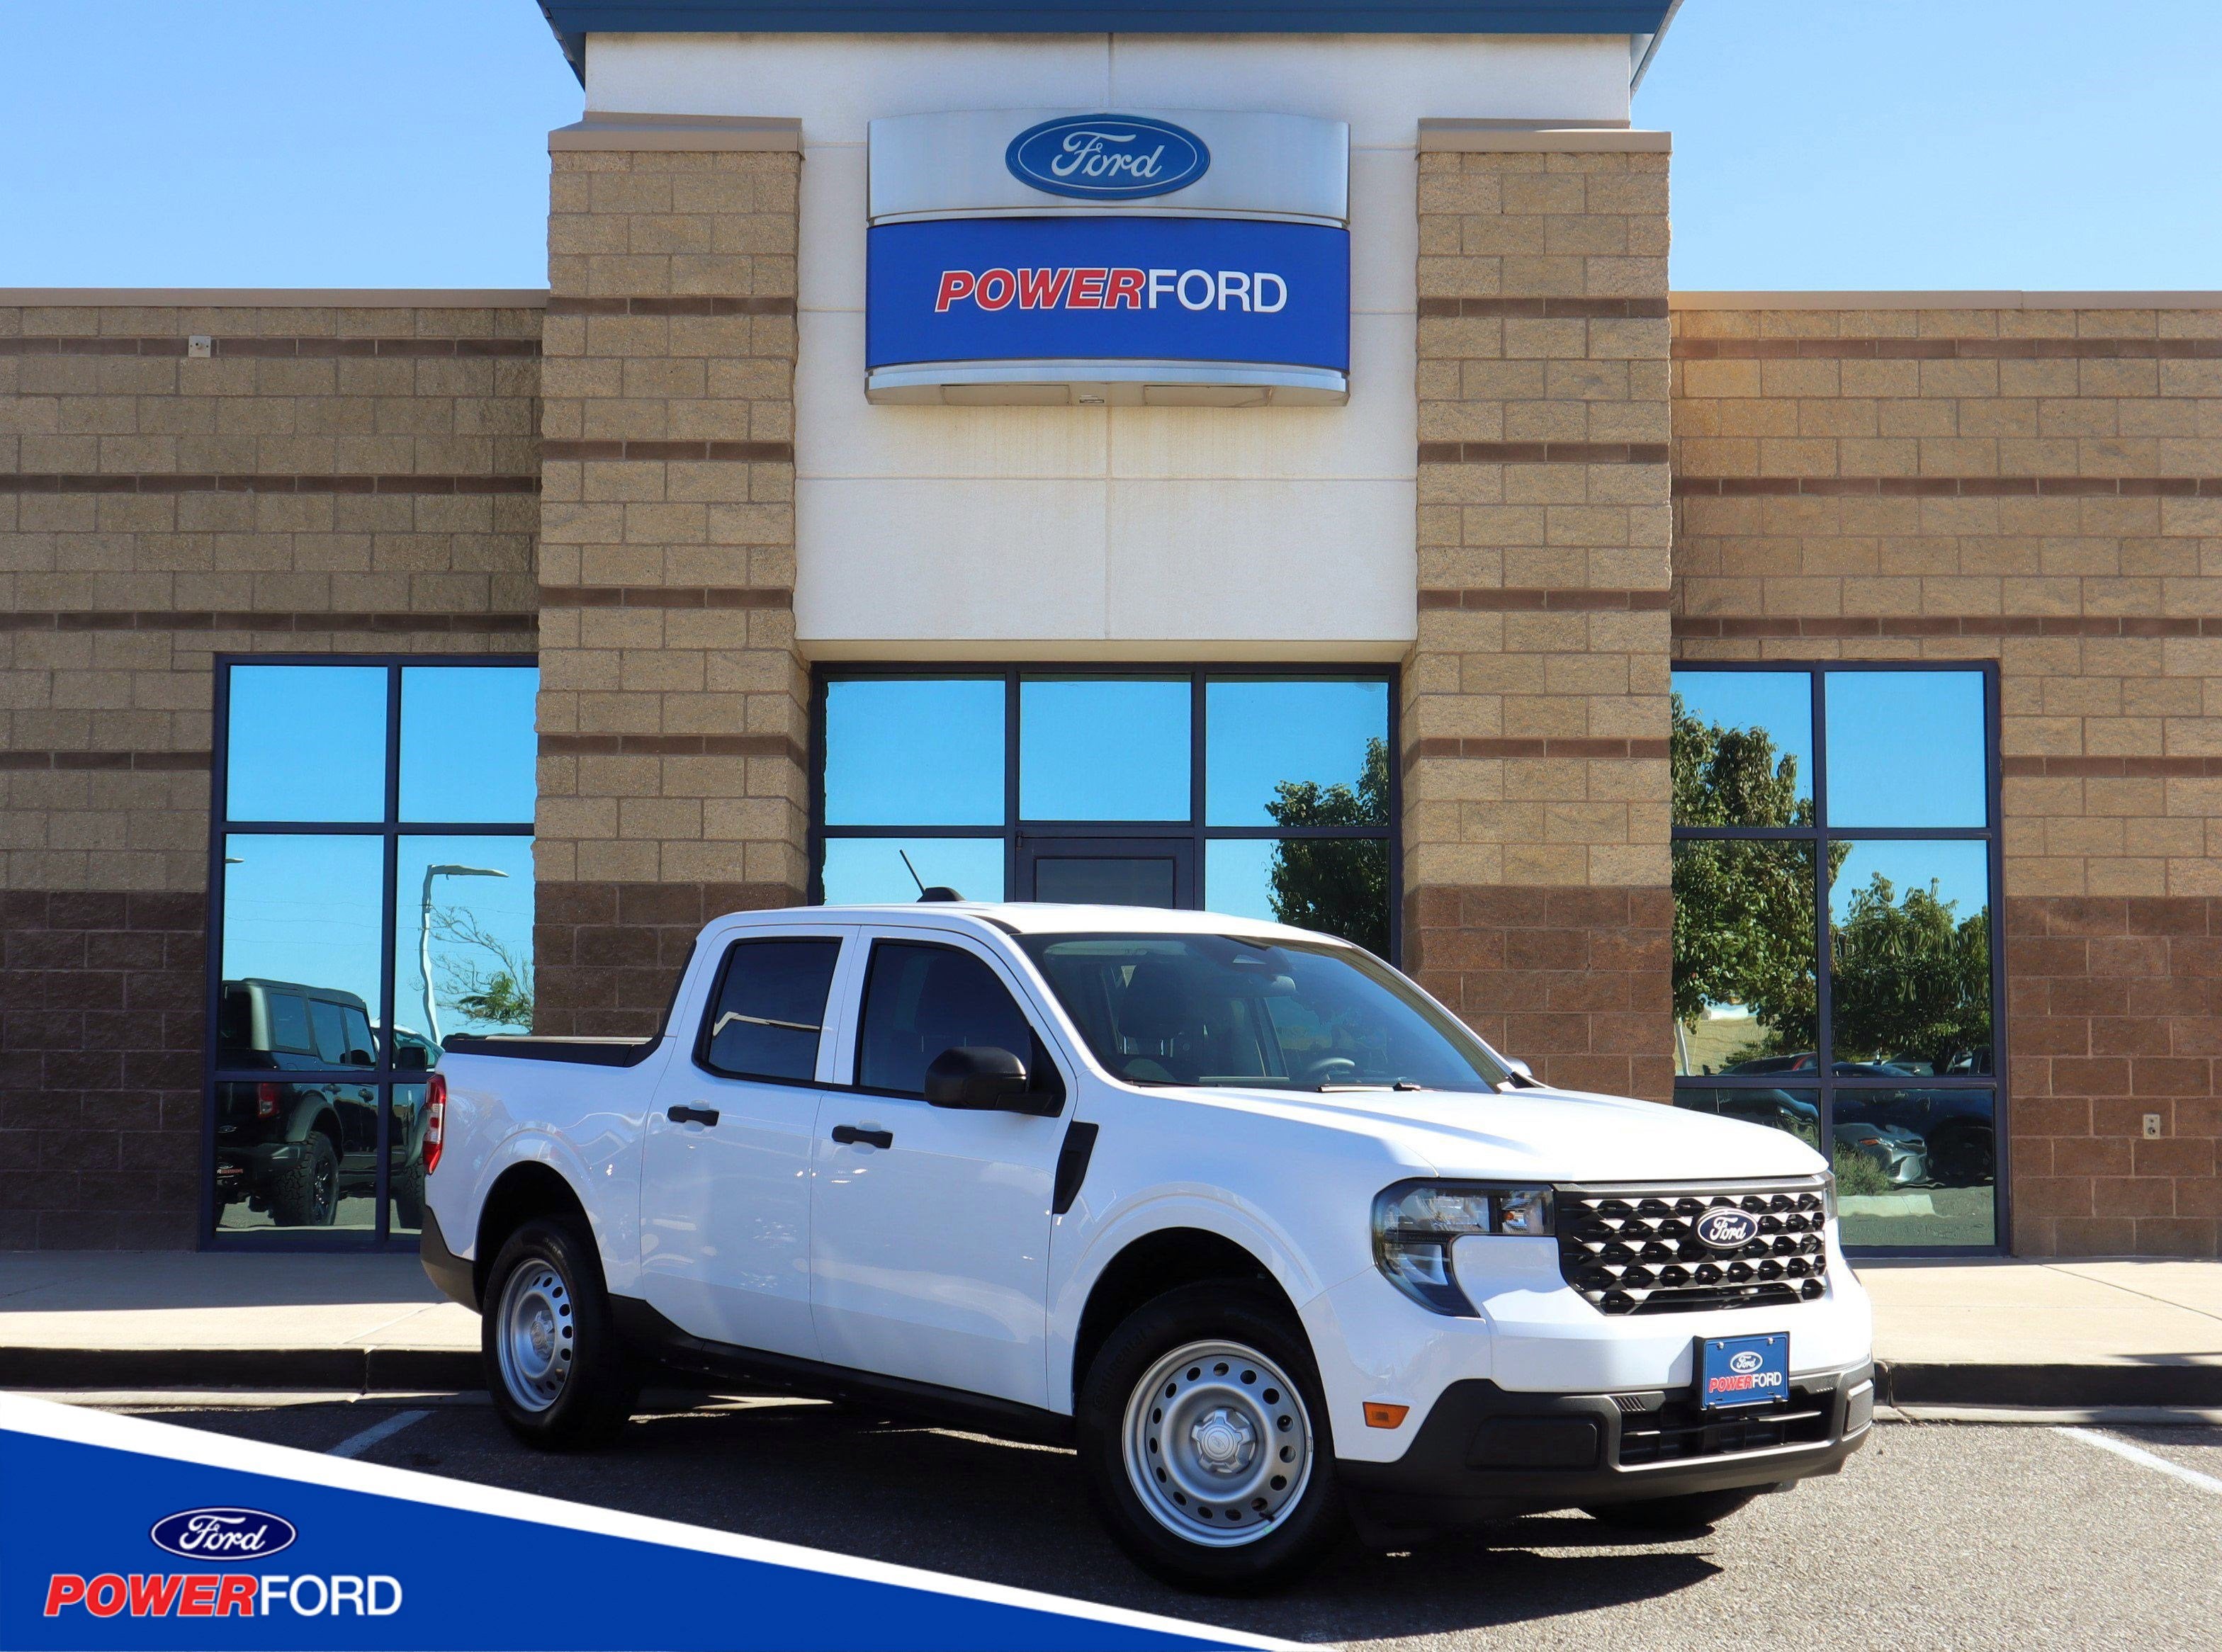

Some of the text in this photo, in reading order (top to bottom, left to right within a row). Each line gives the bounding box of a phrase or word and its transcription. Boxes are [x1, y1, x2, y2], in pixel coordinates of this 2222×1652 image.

[1051, 131, 1163, 178] Ford
[935, 267, 1288, 313] POWERFORD
[1709, 1216, 1747, 1240] Ford
[1736, 1355, 1756, 1369] Ford
[1708, 1371, 1782, 1393] POWERFORD
